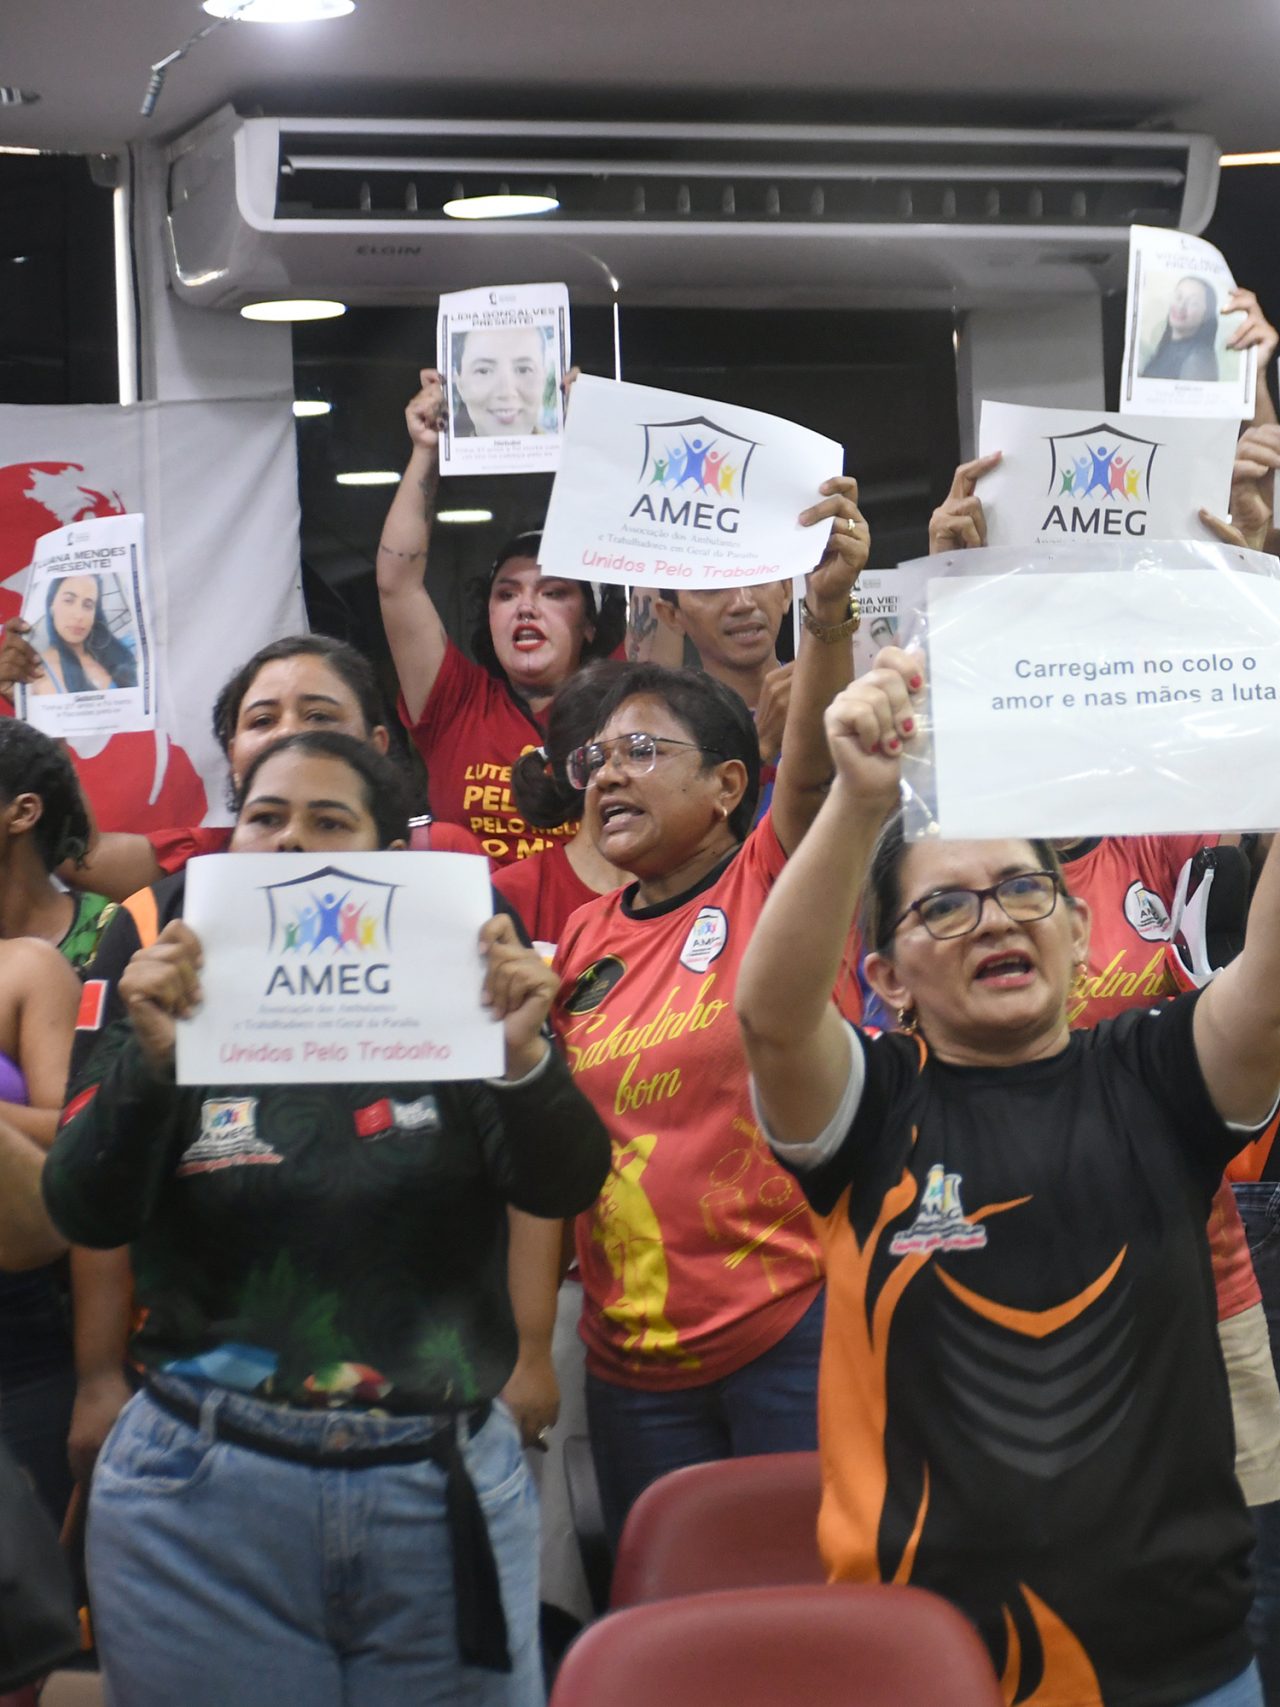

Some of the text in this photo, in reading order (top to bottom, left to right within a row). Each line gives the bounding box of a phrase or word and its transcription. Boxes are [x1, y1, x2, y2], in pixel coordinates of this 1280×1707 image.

[629, 493, 741, 534] AMEG
[1041, 504, 1148, 536] AMEG
[74, 546, 127, 560] MENDES
[582, 549, 781, 579] Unidos Pelo Trabalho
[1015, 654, 1257, 681] Carregam no colo o
[992, 694, 1054, 710] amor
[1062, 694, 1076, 708] e
[1084, 690, 1127, 707] nas
[1136, 685, 1202, 704] mãos
[1211, 688, 1224, 702] a
[463, 785, 518, 812] PEL
[470, 817, 525, 834] PELO
[265, 963, 391, 996] AMEG
[220, 1040, 452, 1064] Unidos Pelo Trabalho
[614, 1053, 682, 1116] bom
